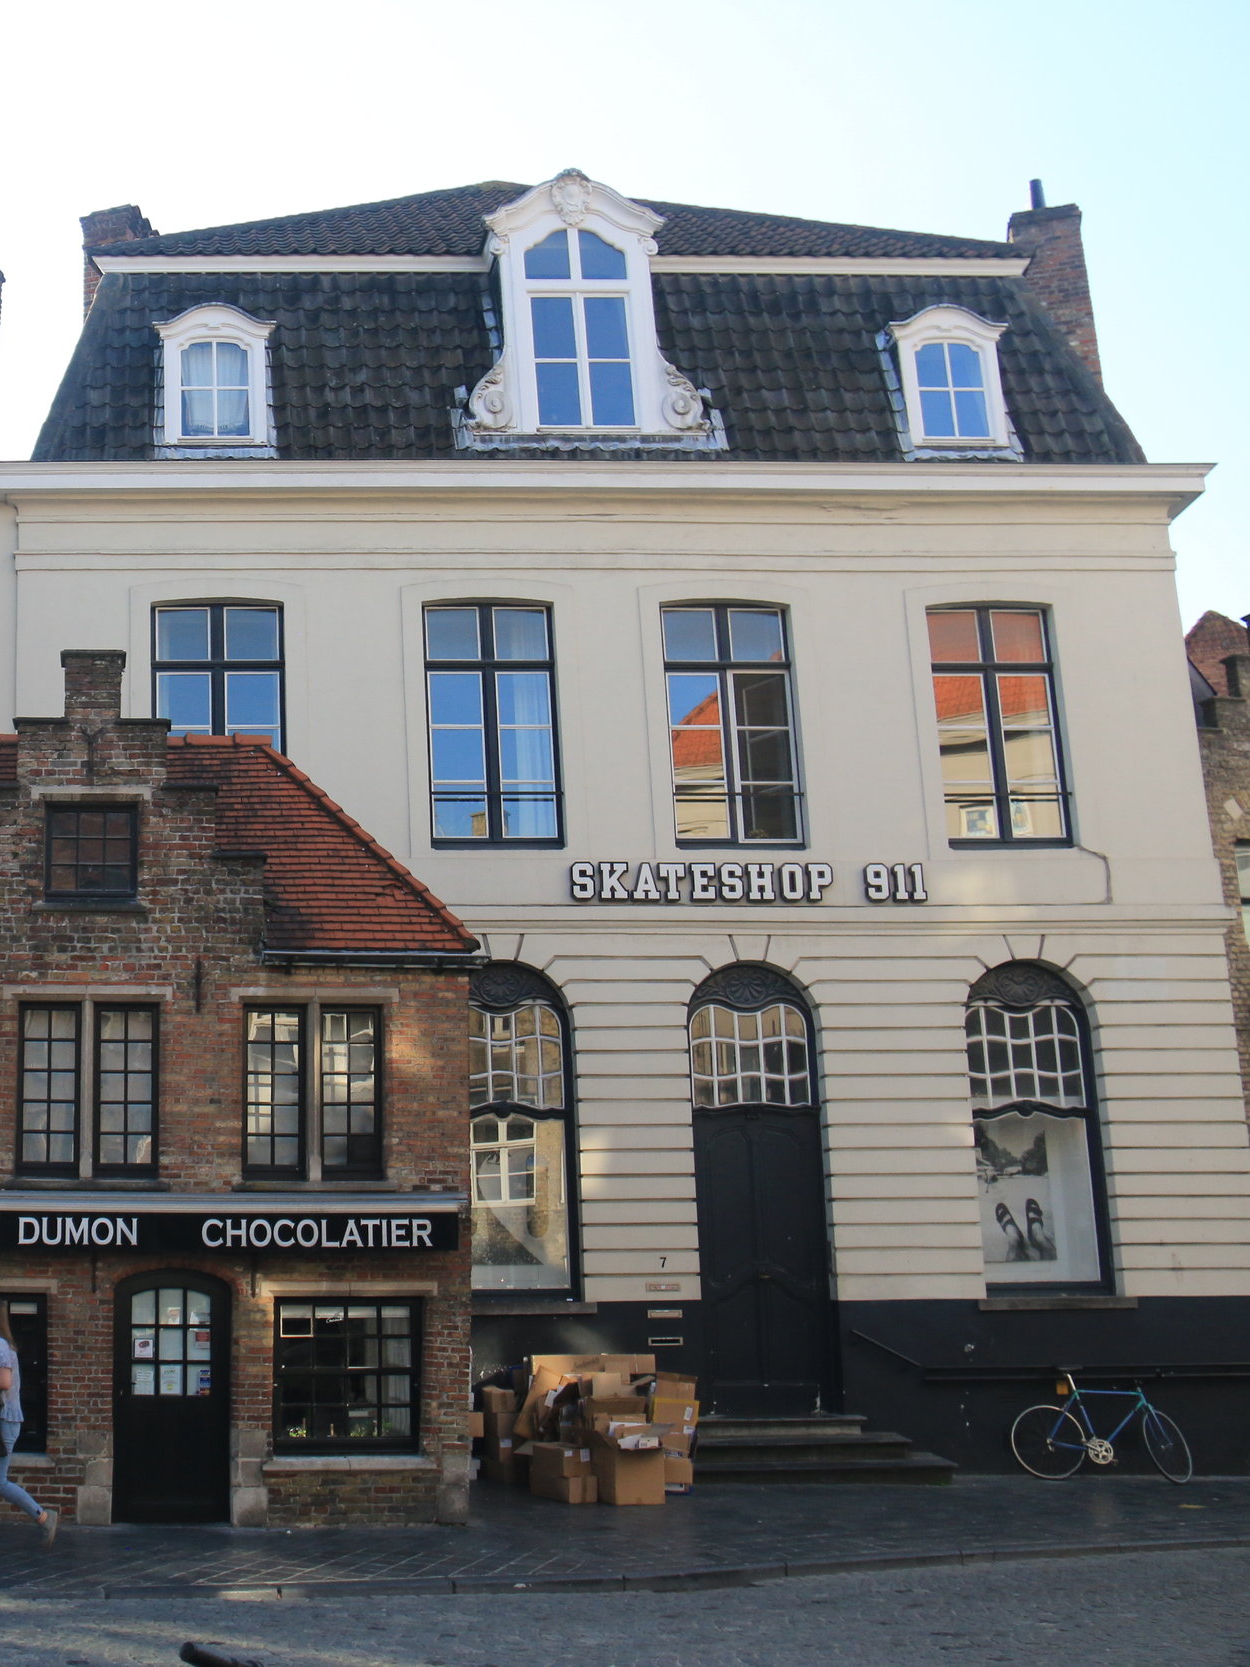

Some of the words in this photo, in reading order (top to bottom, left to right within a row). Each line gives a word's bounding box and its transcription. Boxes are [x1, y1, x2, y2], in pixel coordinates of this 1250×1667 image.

[570, 861, 834, 903] SKATESHOP
[864, 862, 928, 903] 911
[17, 1216, 139, 1247] DUMON
[200, 1217, 434, 1249] CHOCOLATIER
[659, 1256, 667, 1269] 7
